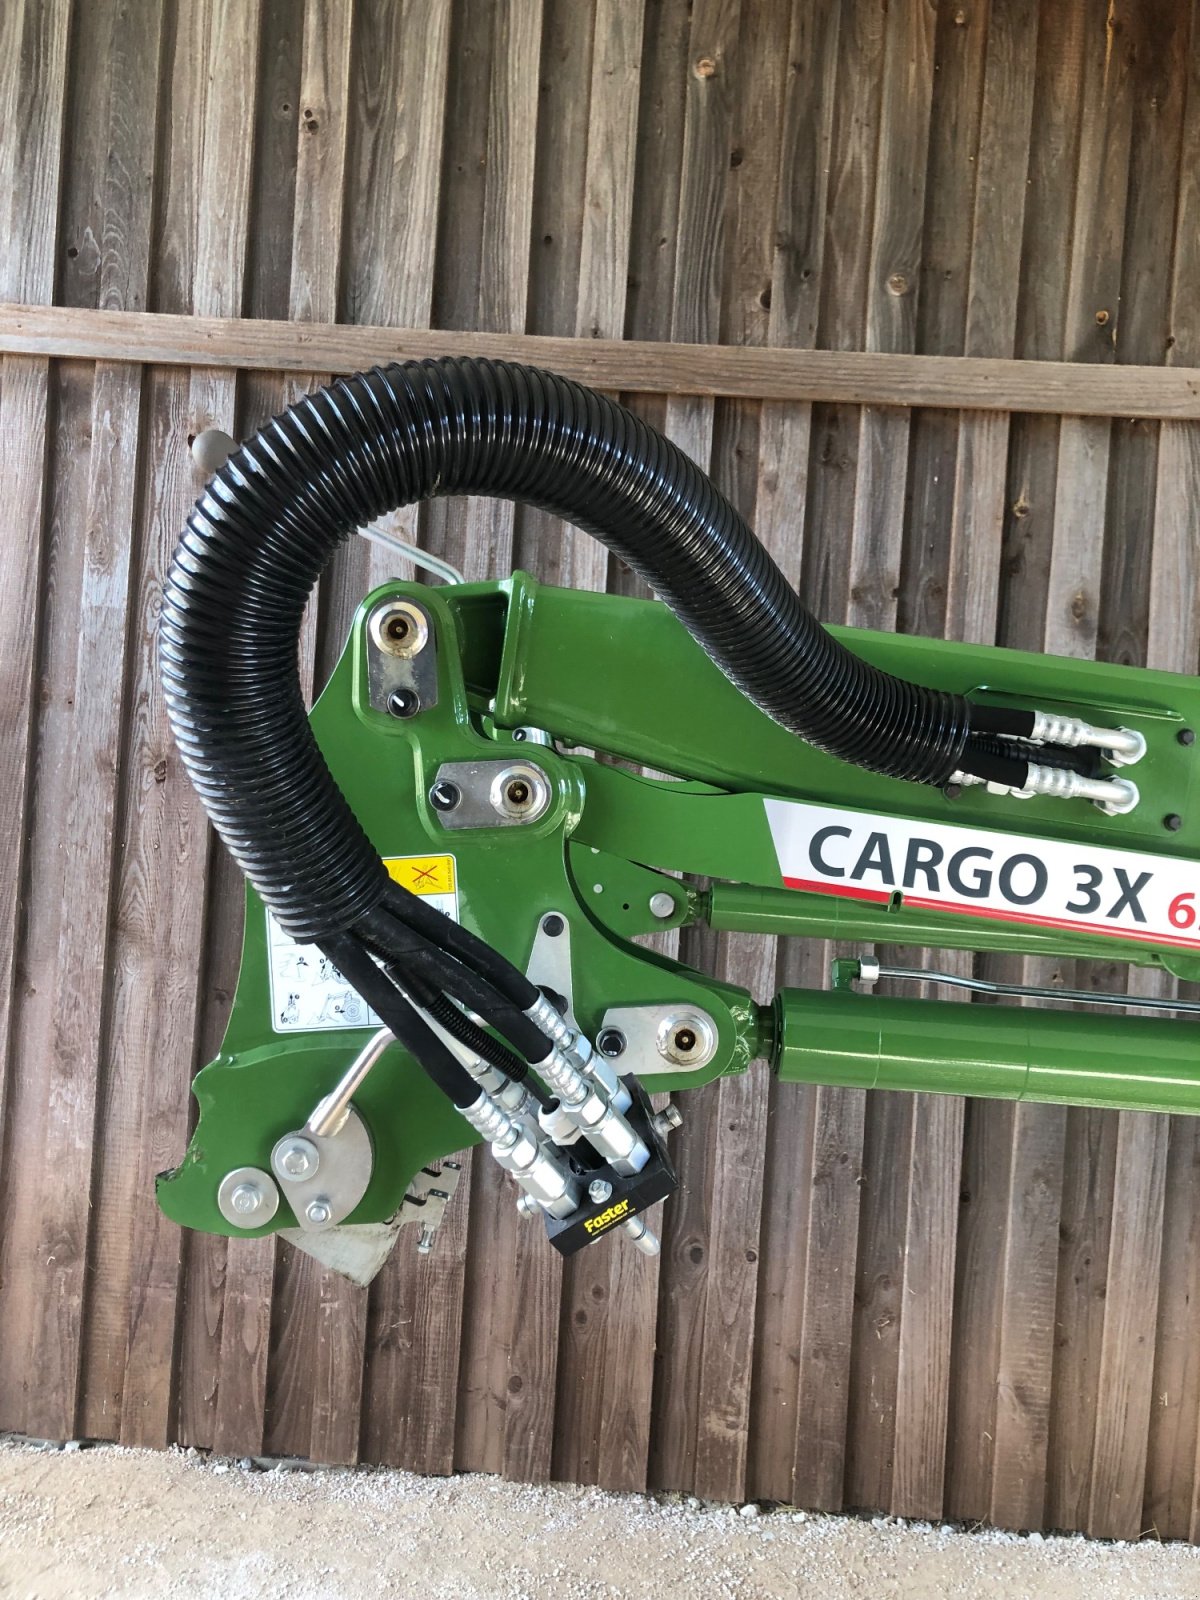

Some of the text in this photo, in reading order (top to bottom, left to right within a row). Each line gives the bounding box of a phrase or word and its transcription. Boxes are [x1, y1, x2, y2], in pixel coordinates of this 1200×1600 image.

[808, 825, 1200, 931] CARGO 3X 6
[584, 1199, 629, 1233] Faster
